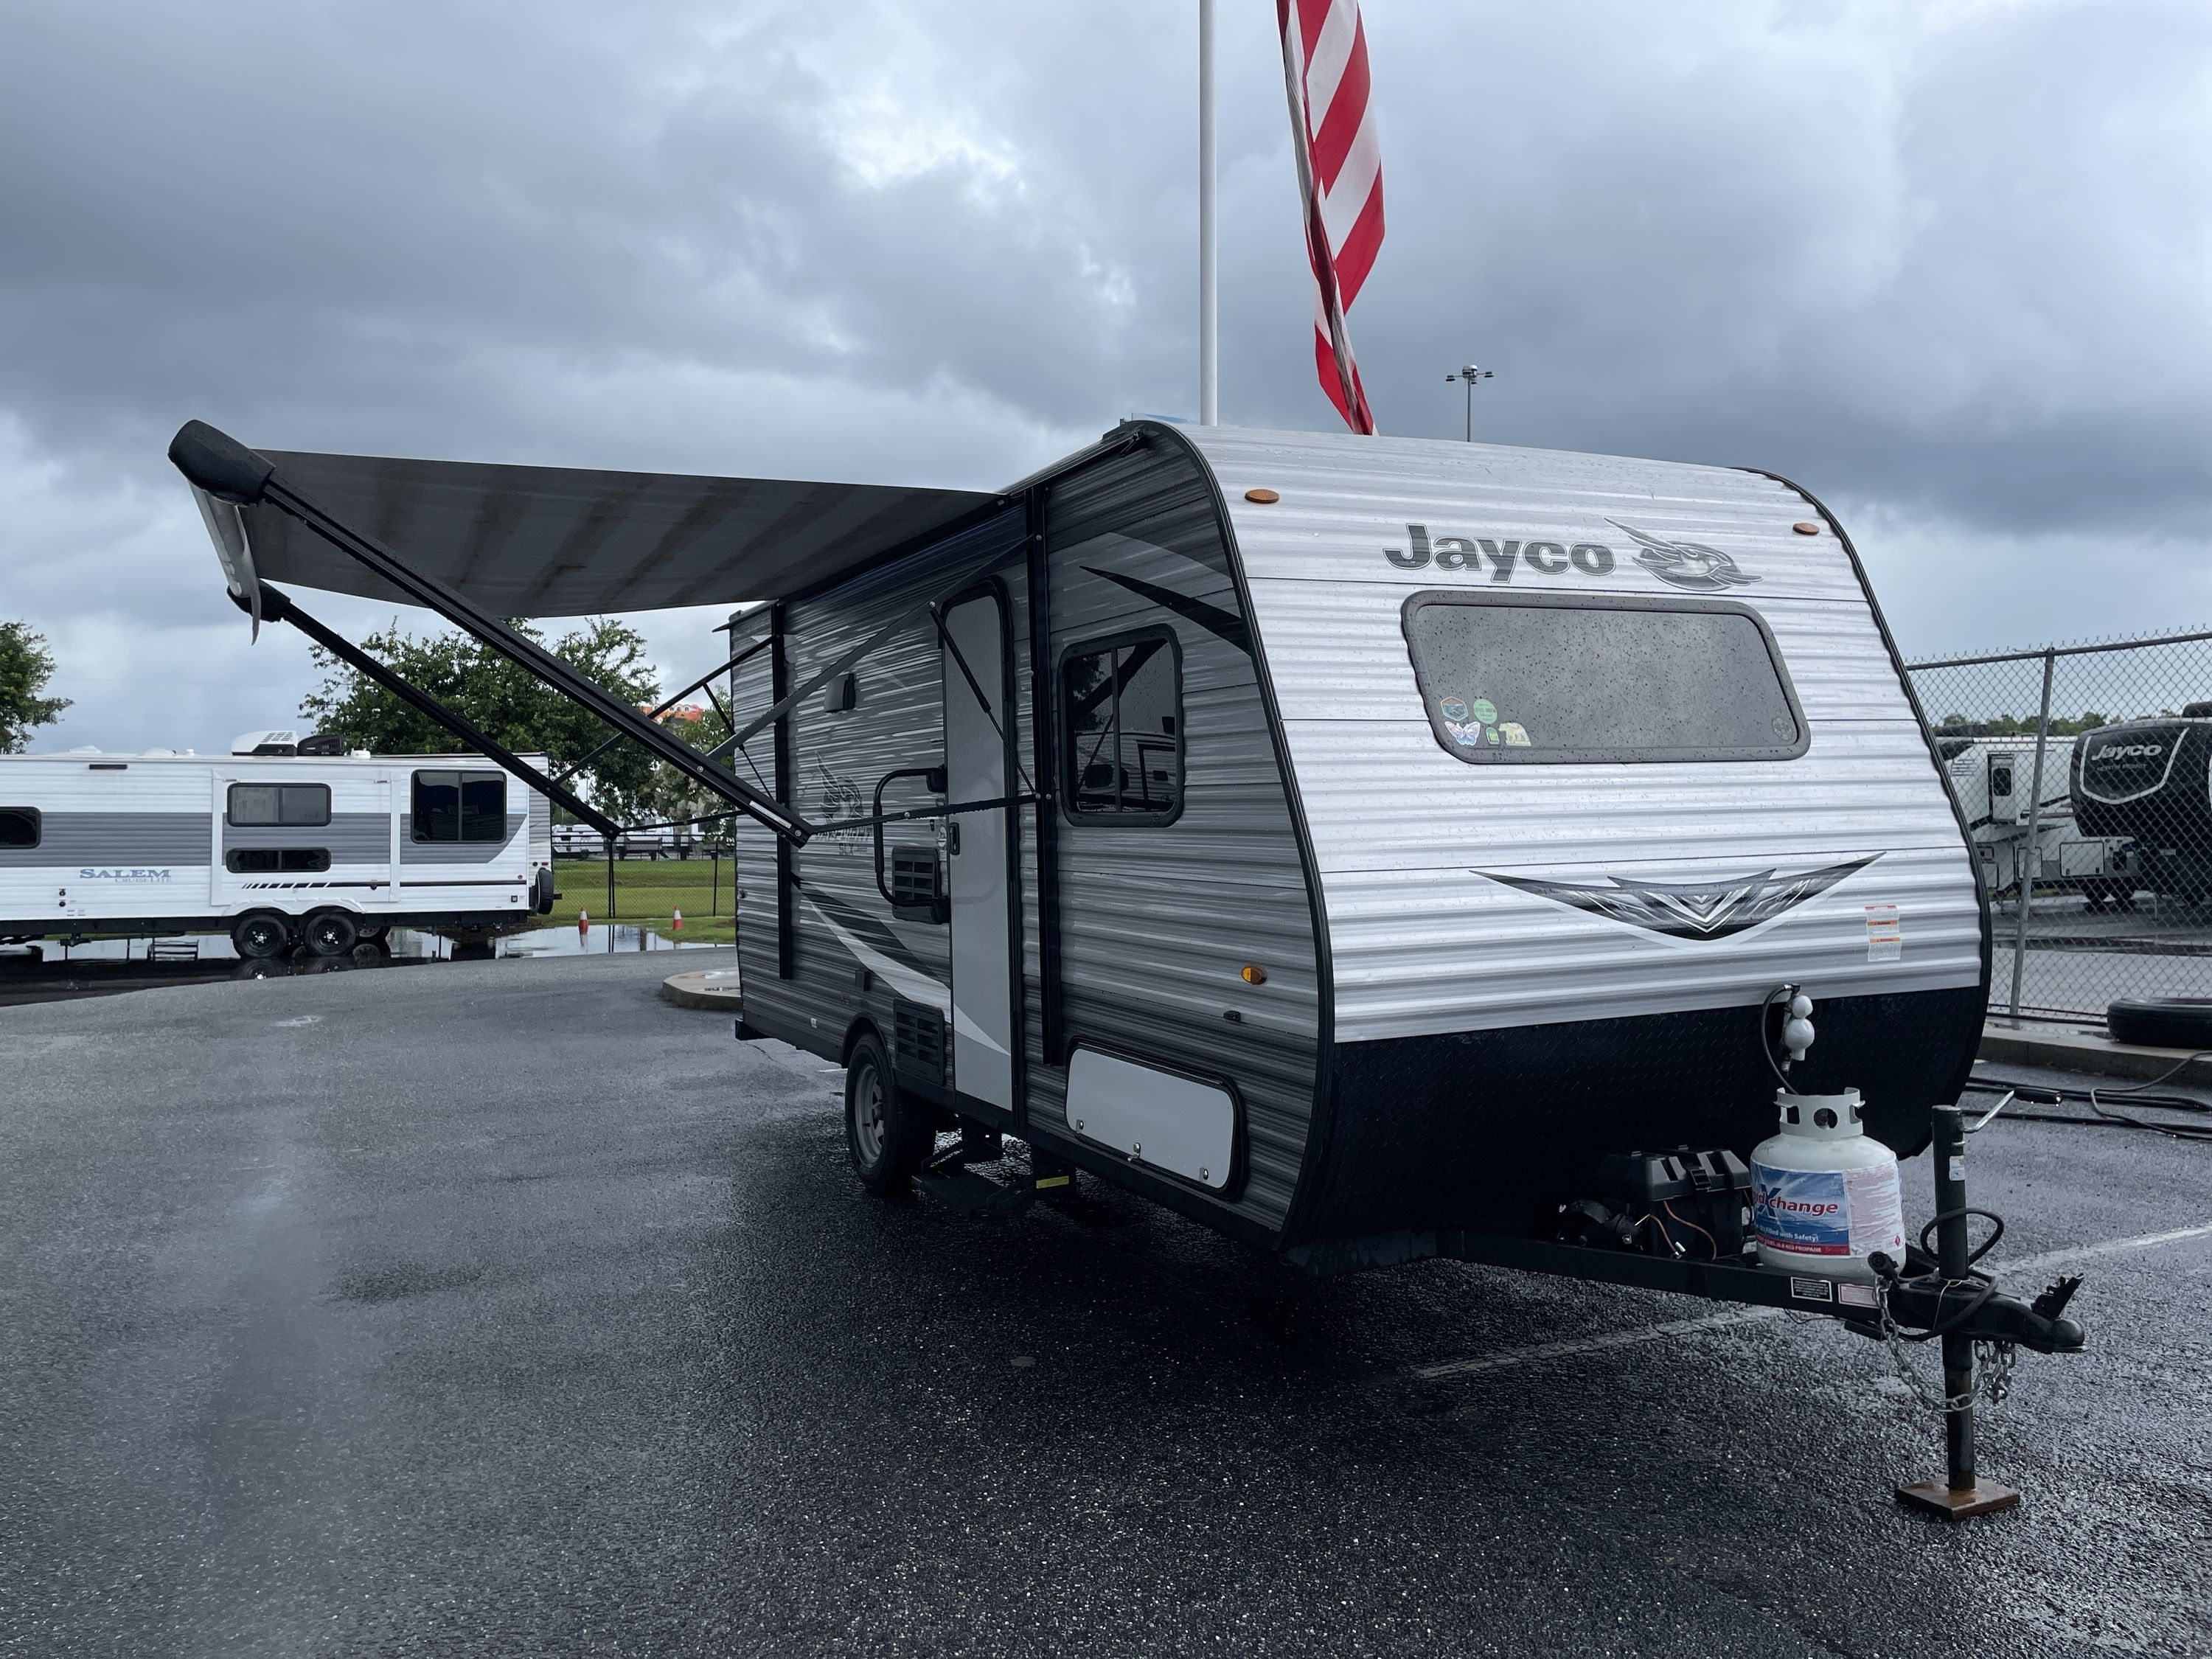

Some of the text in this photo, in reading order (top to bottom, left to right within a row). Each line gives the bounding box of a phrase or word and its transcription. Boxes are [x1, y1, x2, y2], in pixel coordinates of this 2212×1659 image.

[1382, 523, 1616, 583] Jayco
[2091, 744, 2162, 761] Jayco
[80, 869, 171, 878] SALEM
